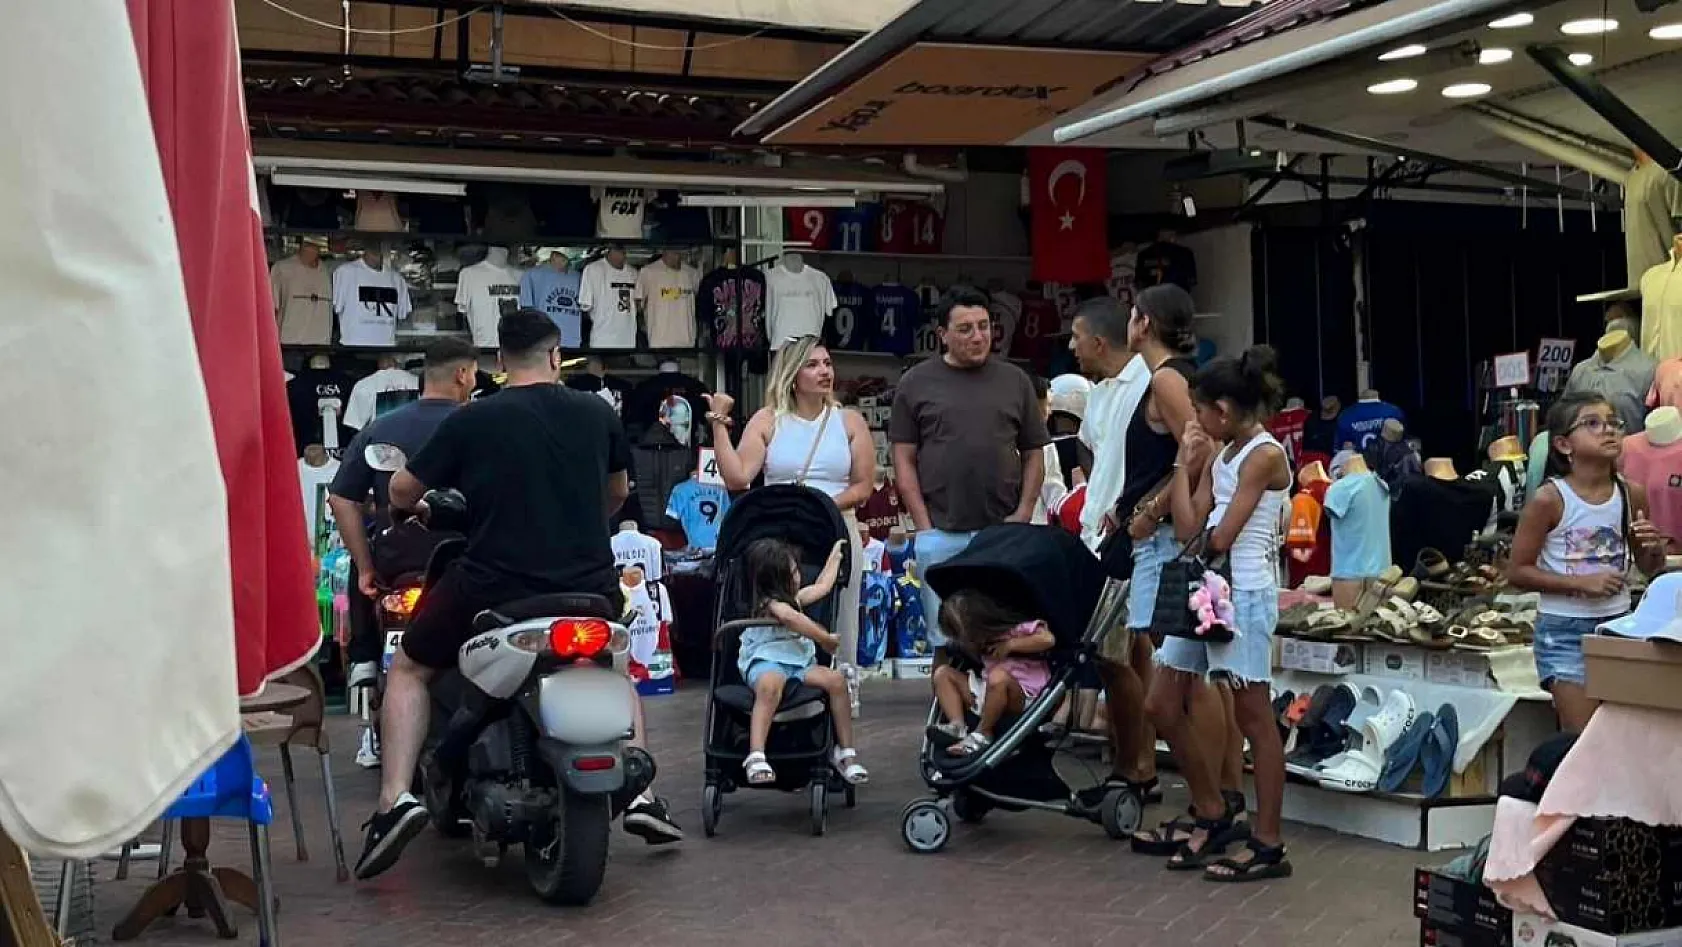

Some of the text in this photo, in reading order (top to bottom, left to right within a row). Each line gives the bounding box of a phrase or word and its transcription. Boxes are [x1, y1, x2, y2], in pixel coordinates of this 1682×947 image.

[803, 210, 824, 240] 9
[835, 307, 854, 348] 9
[1542, 345, 1570, 363] 200
[700, 501, 717, 525] 9
